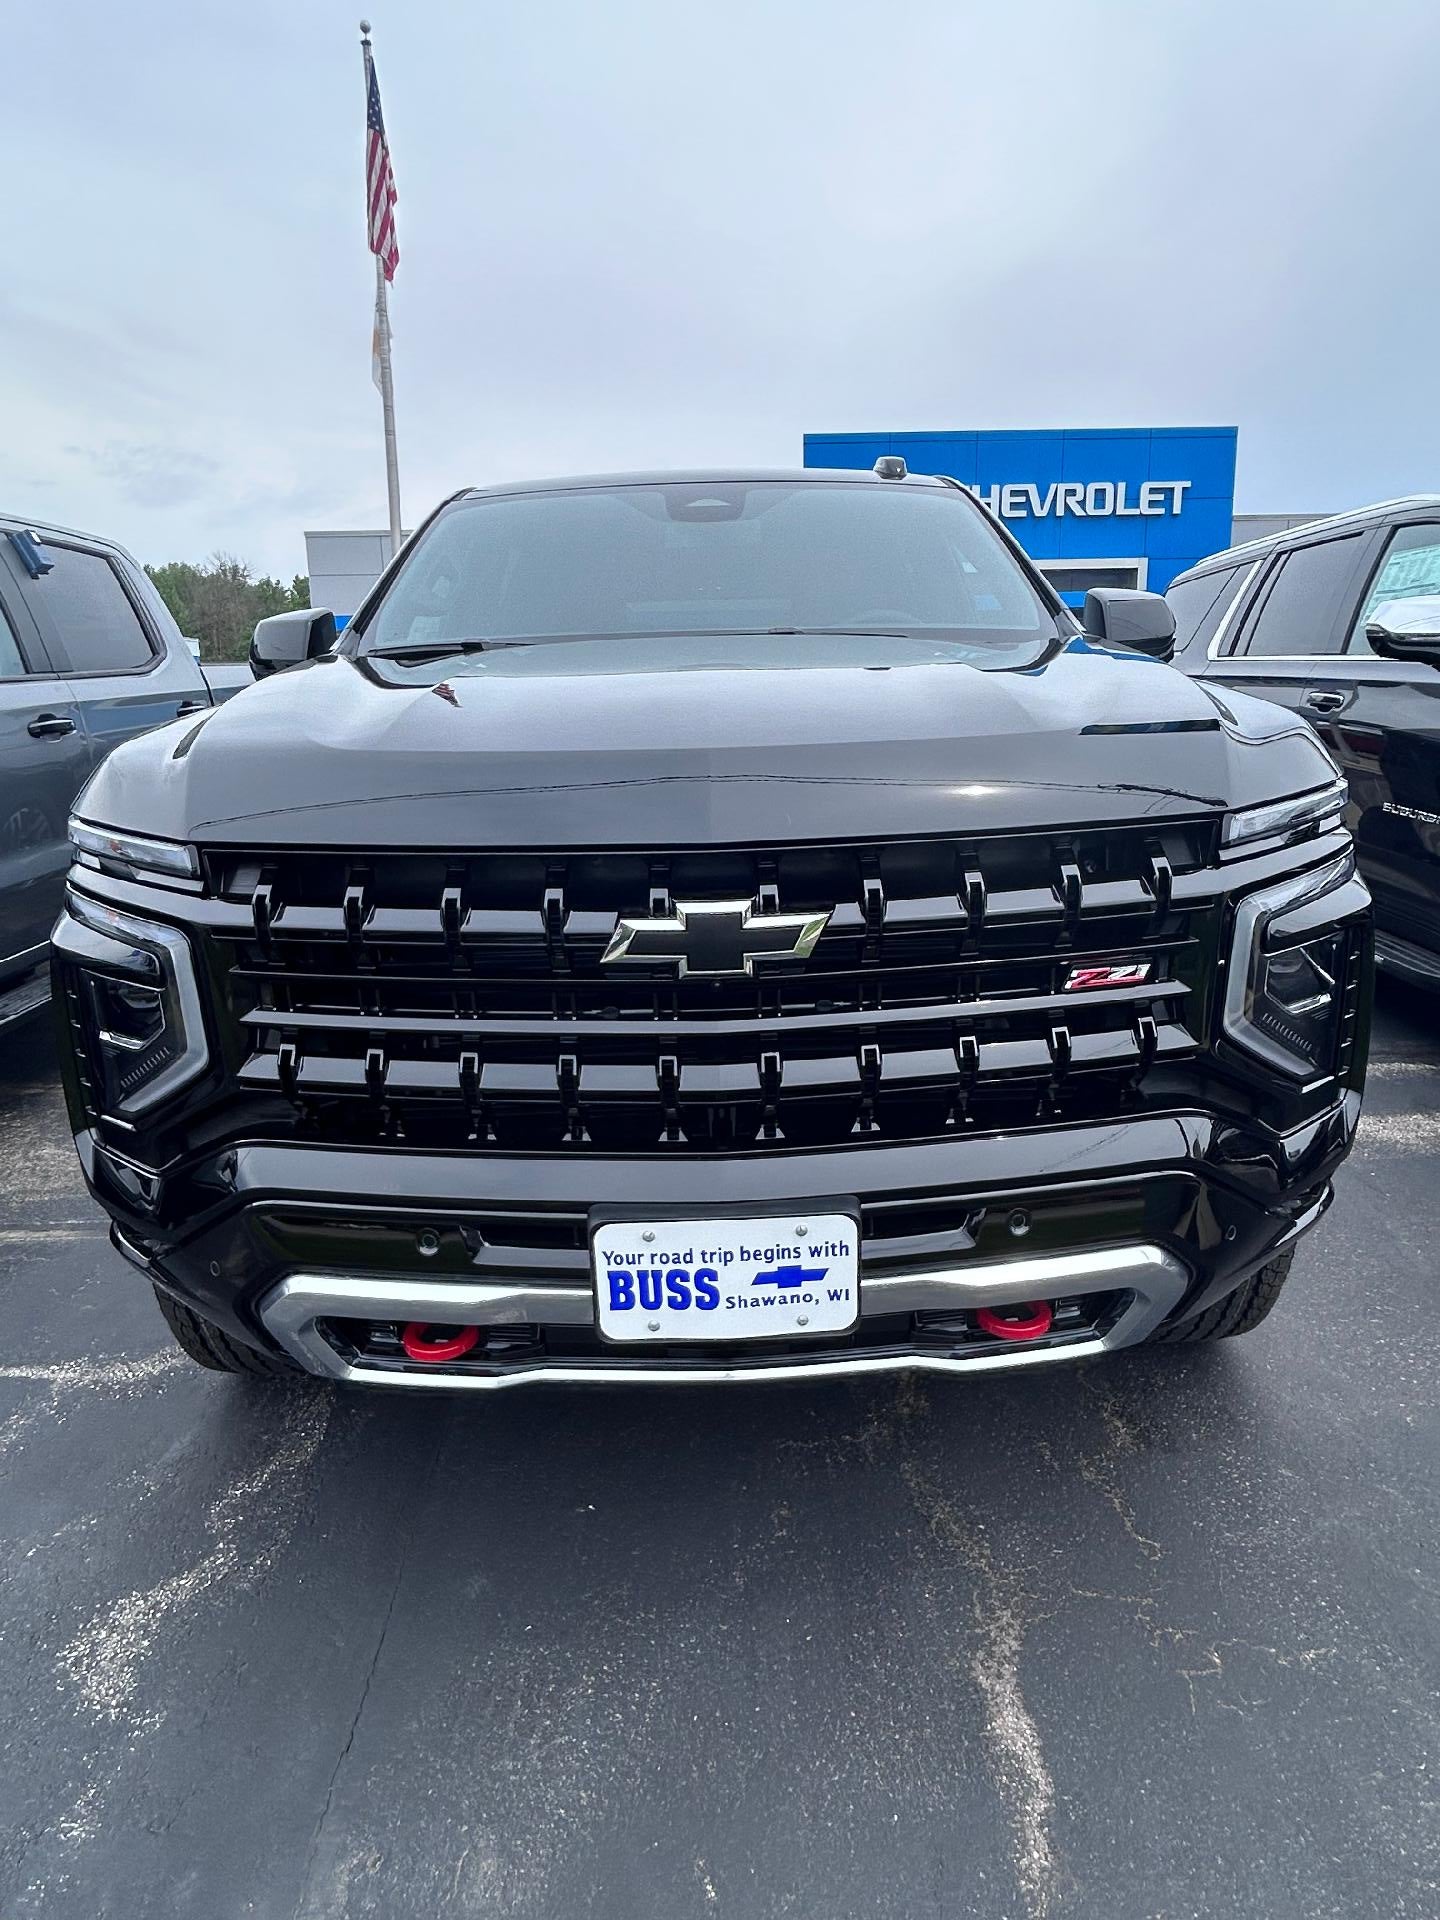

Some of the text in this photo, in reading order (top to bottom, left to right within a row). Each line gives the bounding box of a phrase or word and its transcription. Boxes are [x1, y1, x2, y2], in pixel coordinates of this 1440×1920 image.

[970, 480, 1192, 518] HEVROLET
[1382, 802, 1440, 824] SUBURB
[1064, 963, 1151, 990] Z71
[602, 1240, 850, 1266] Your road trip begins with
[607, 1267, 720, 1311] BUSS
[725, 1288, 850, 1309] Shawano, WI
